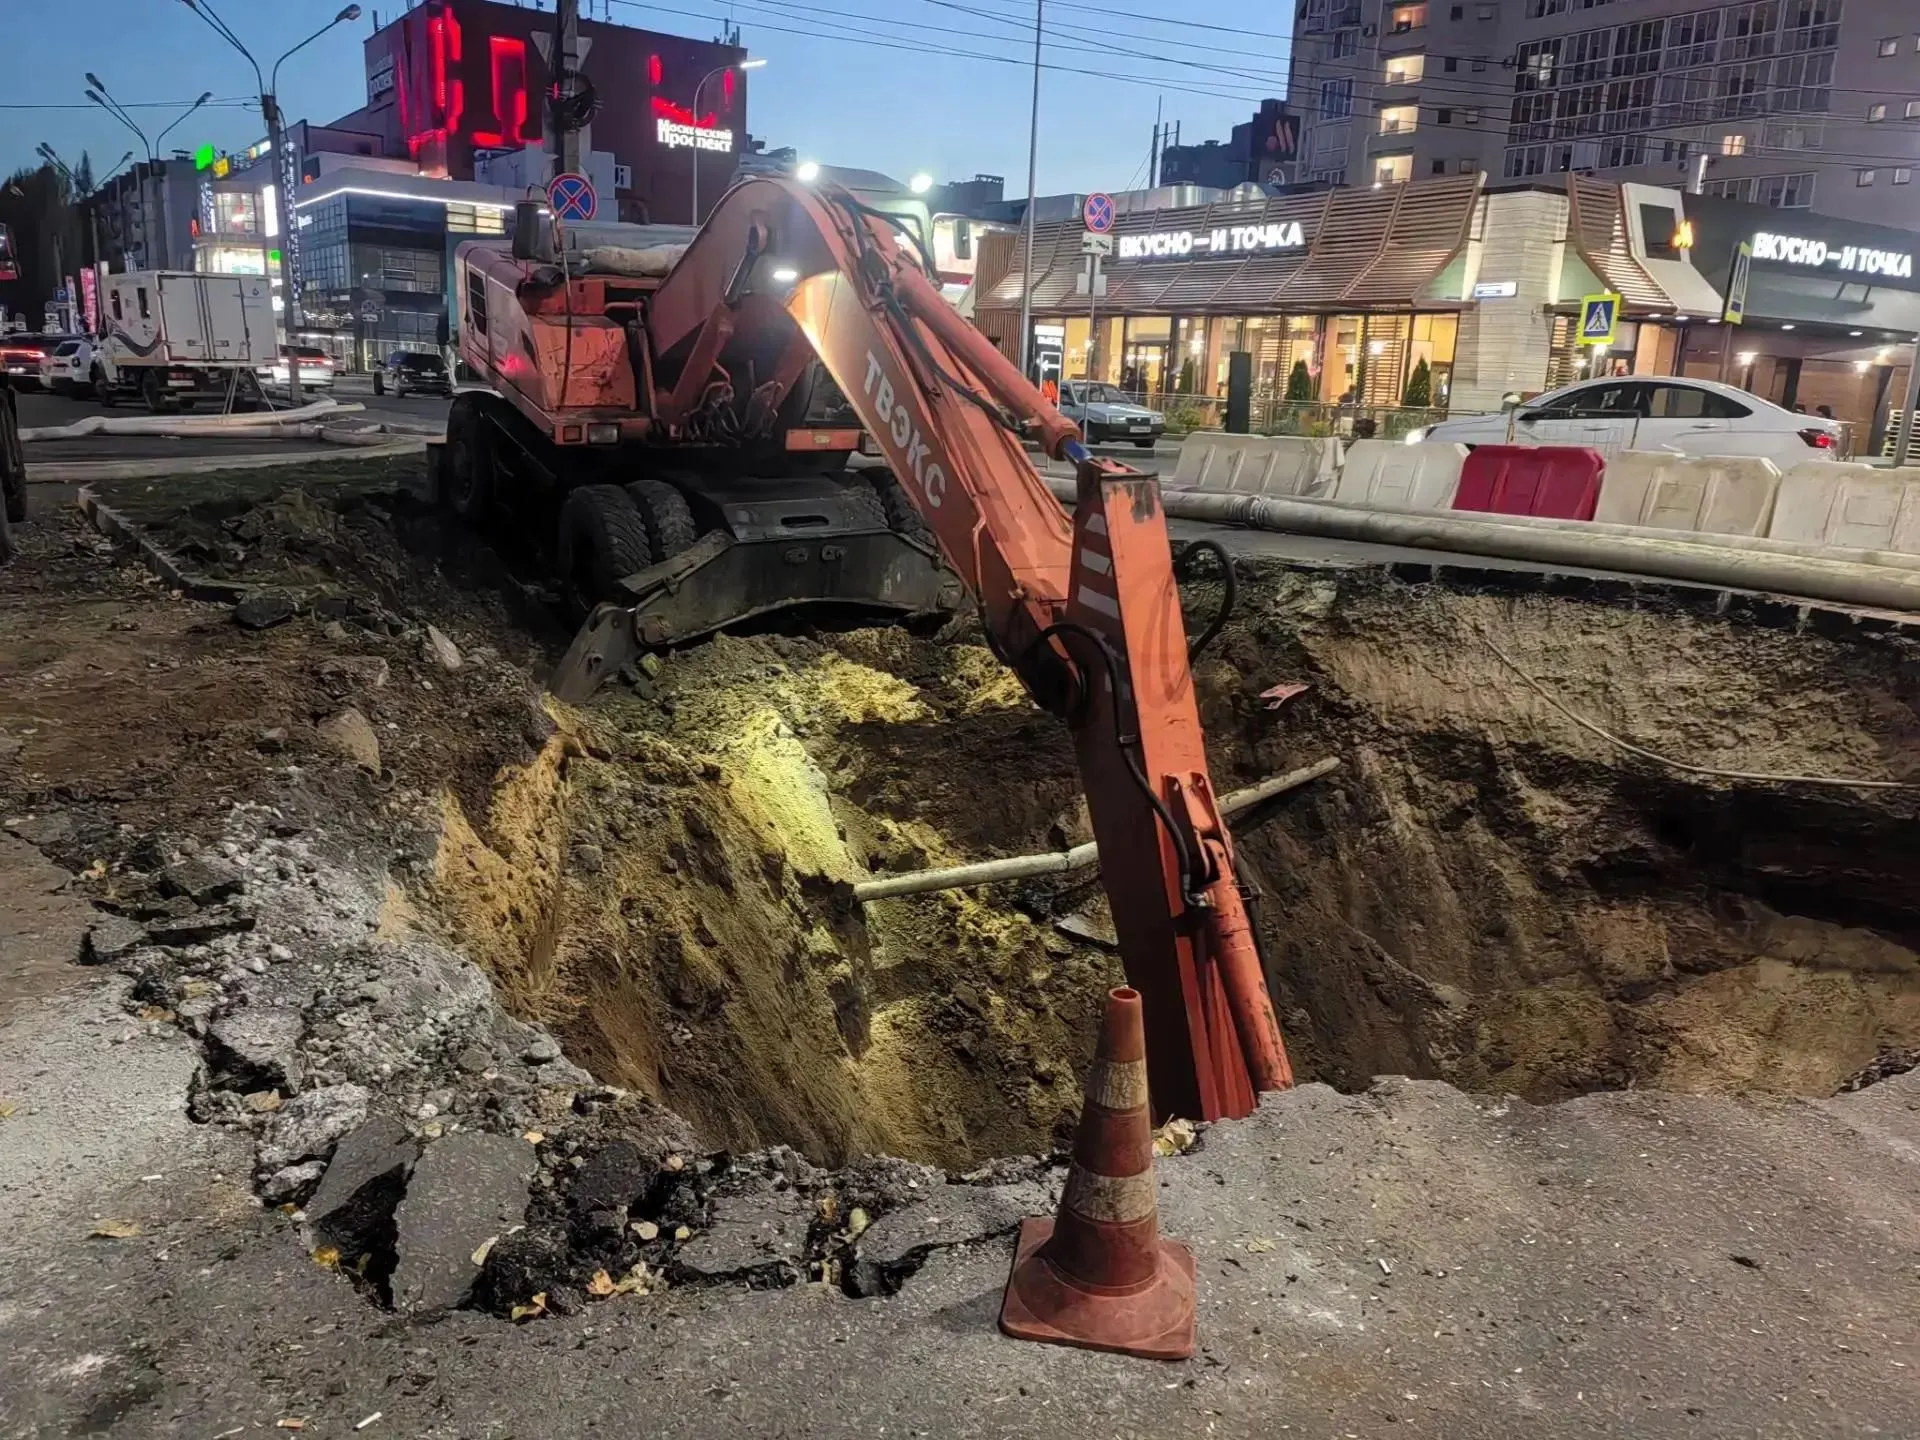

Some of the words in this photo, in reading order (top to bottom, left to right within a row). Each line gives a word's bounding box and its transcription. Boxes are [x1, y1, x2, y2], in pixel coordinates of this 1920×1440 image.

[657, 129, 732, 152] Проспект
[1230, 222, 1305, 251] ТОЧКА
[1858, 248, 1912, 278] ТОЧКА
[863, 349, 946, 508] ТВЭКС
